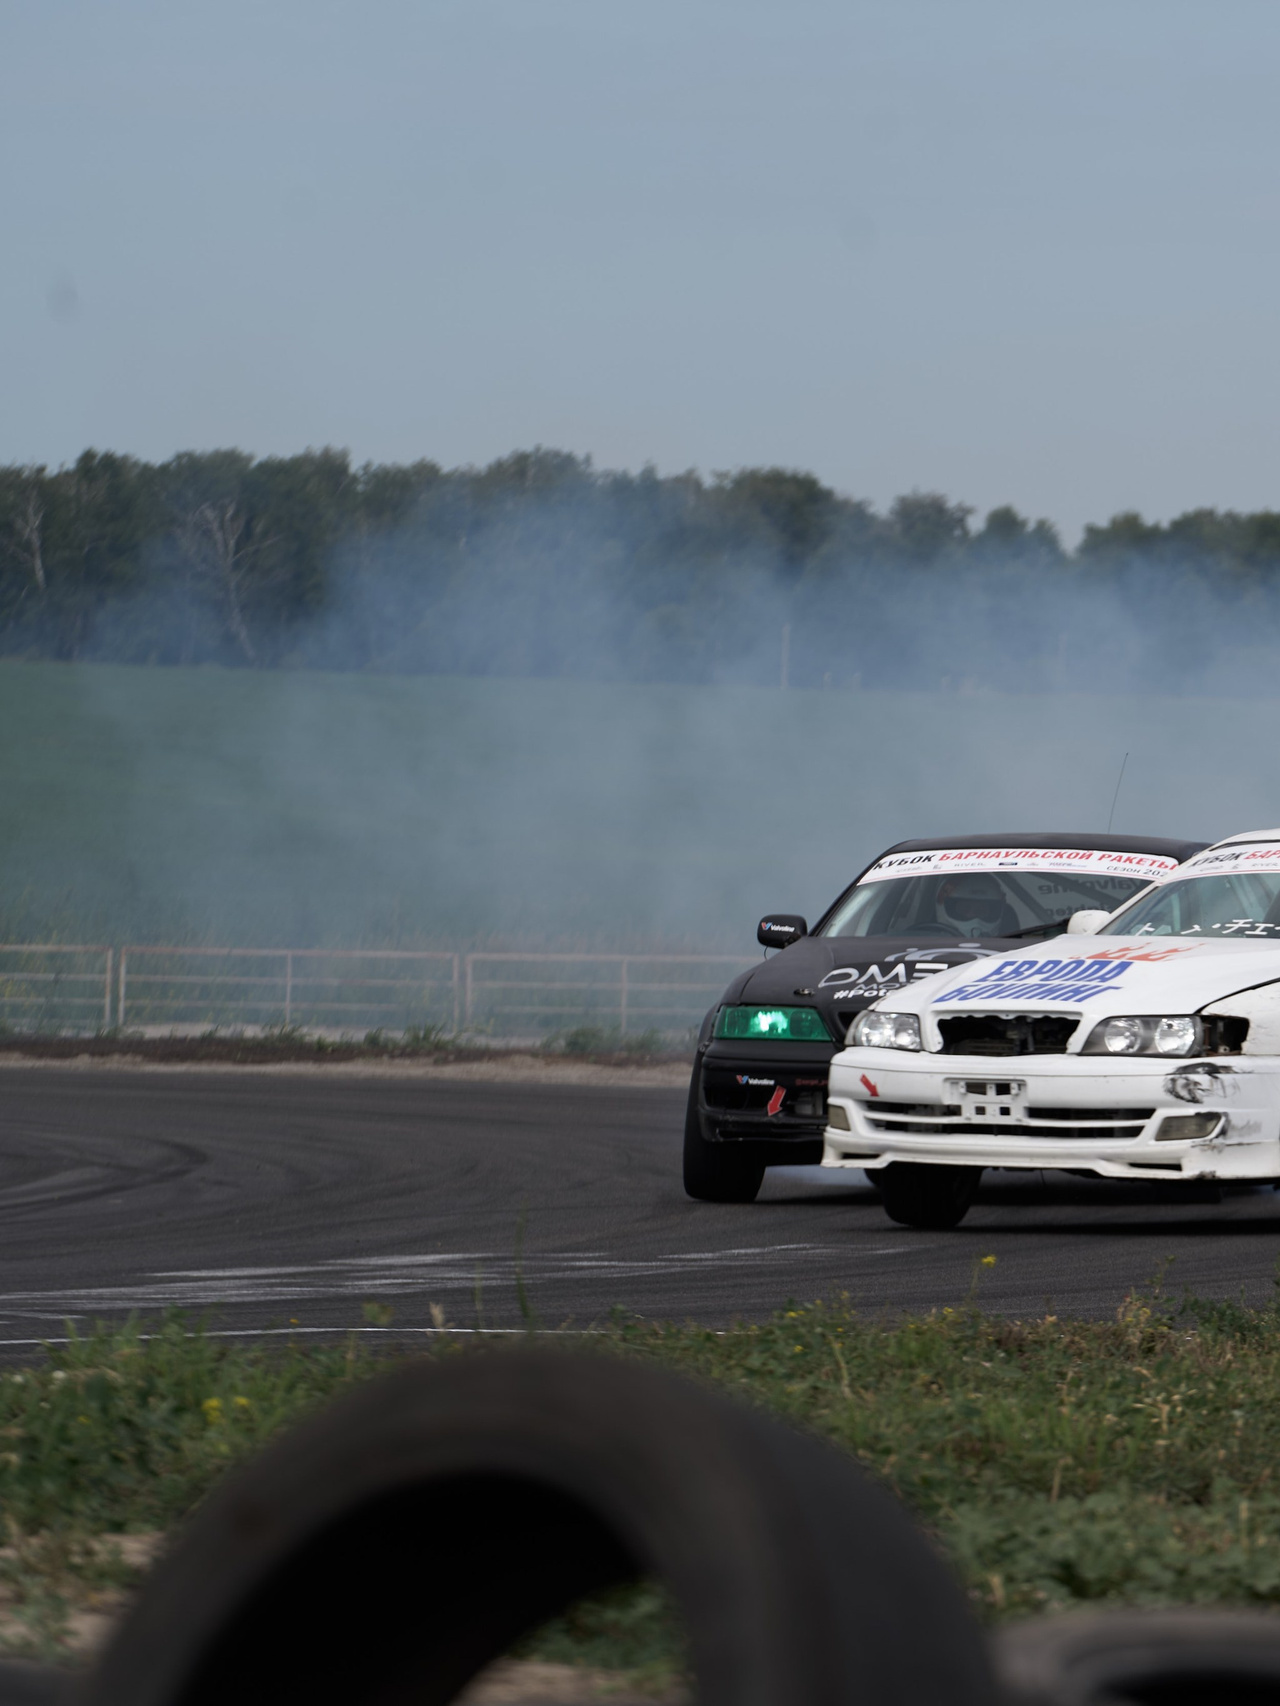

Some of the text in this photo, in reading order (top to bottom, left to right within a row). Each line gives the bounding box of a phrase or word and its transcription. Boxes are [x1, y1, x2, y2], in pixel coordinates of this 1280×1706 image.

[873, 850, 1179, 870] КУБОК БАРНАУЛЬСКОЙ РАКЕТЫ
[1106, 865, 1169, 877] СЕЗОН 202
[973, 959, 1134, 983] ЕВРОПА
[931, 983, 1123, 1003] БОУЛИНГ
